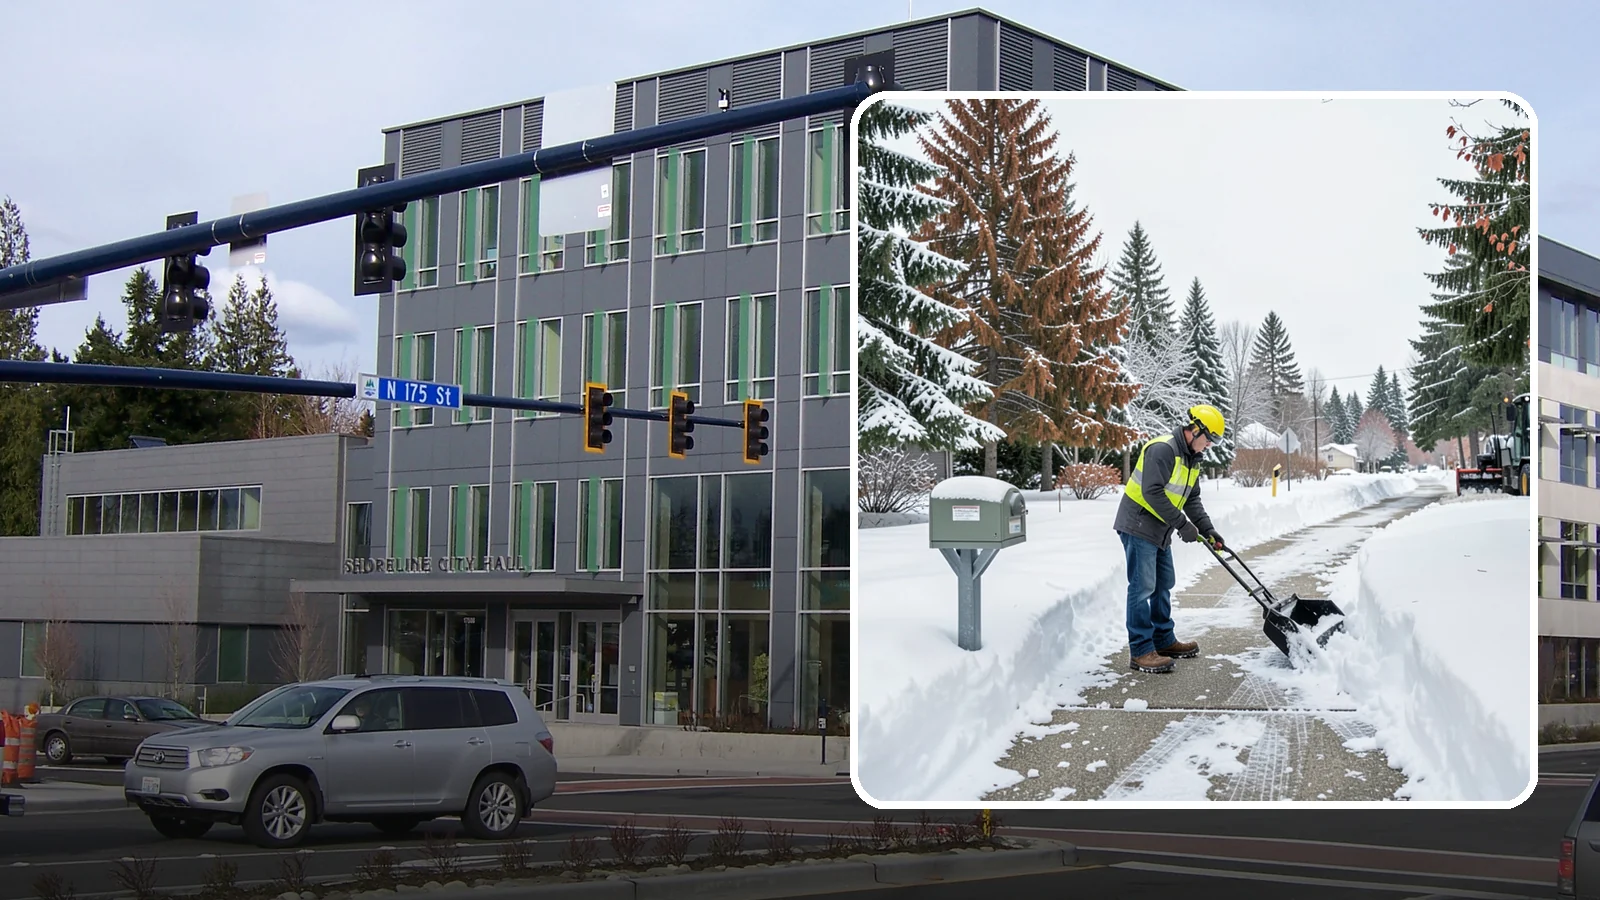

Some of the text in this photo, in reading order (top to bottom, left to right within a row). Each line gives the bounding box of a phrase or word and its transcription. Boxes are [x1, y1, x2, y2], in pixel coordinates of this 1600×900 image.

[387, 380, 451, 405] N 175 St
[344, 555, 525, 574] SHORELINE CITY HALL
